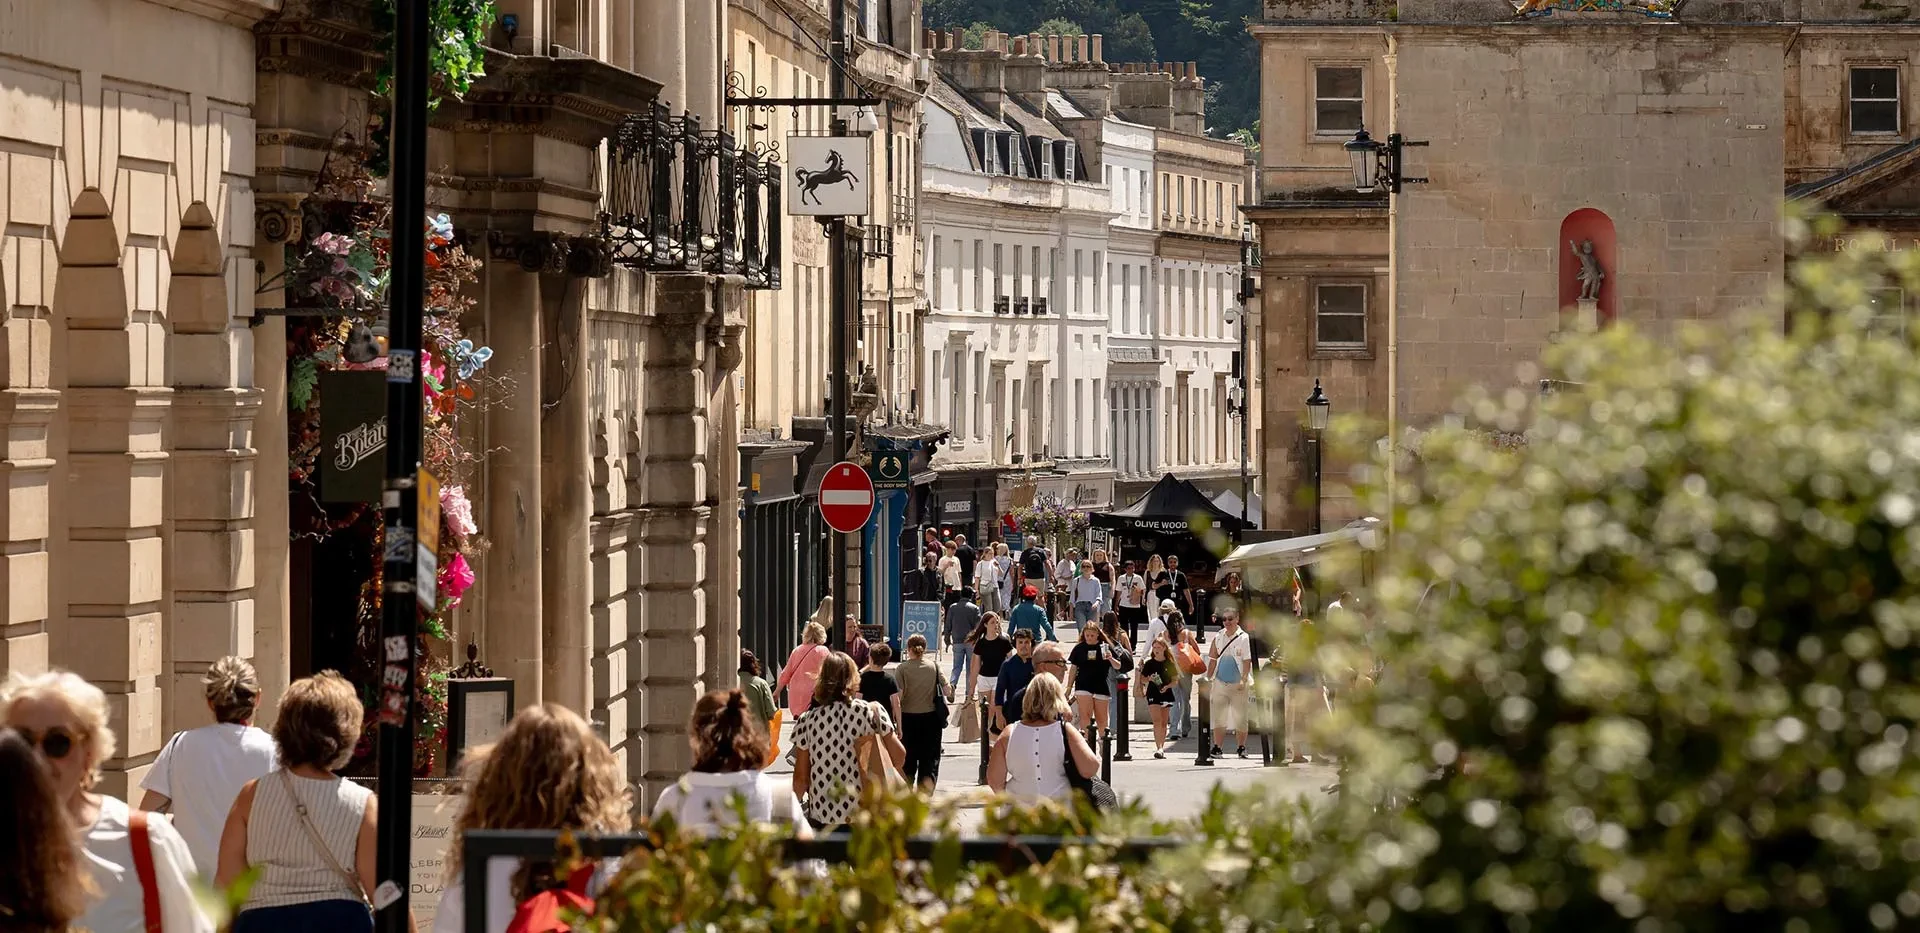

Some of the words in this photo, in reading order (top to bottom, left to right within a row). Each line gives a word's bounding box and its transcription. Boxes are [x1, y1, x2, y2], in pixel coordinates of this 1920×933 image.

[1834, 238, 1902, 252] ROAL
[335, 416, 387, 471] Botan
[1135, 520, 1159, 528] OLIVE
[1161, 521, 1188, 529] WOOD
